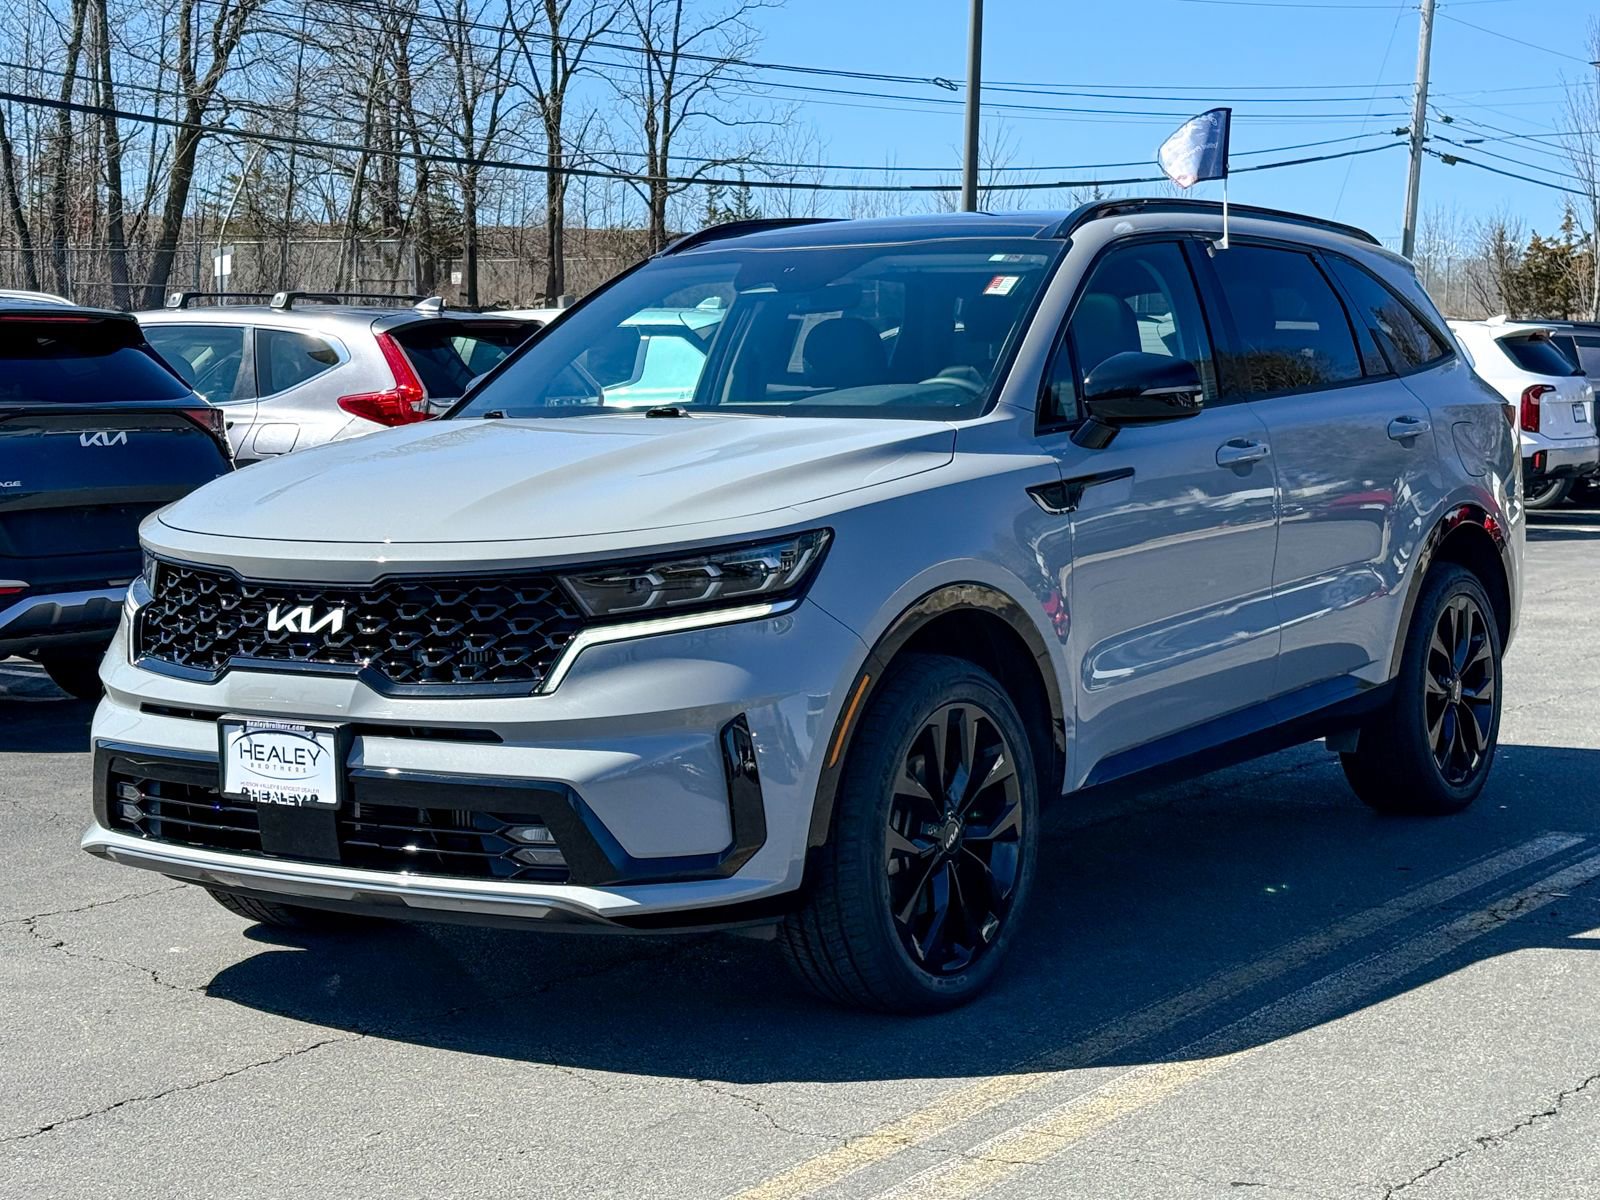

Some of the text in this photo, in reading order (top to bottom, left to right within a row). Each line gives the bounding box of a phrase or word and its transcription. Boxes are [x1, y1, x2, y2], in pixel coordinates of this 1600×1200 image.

[80, 431, 128, 447] KIA
[267, 604, 345, 635] KIA
[240, 742, 321, 766] HEALEY
[250, 763, 306, 773] BROTHERS
[249, 789, 305, 807] HEALEY
